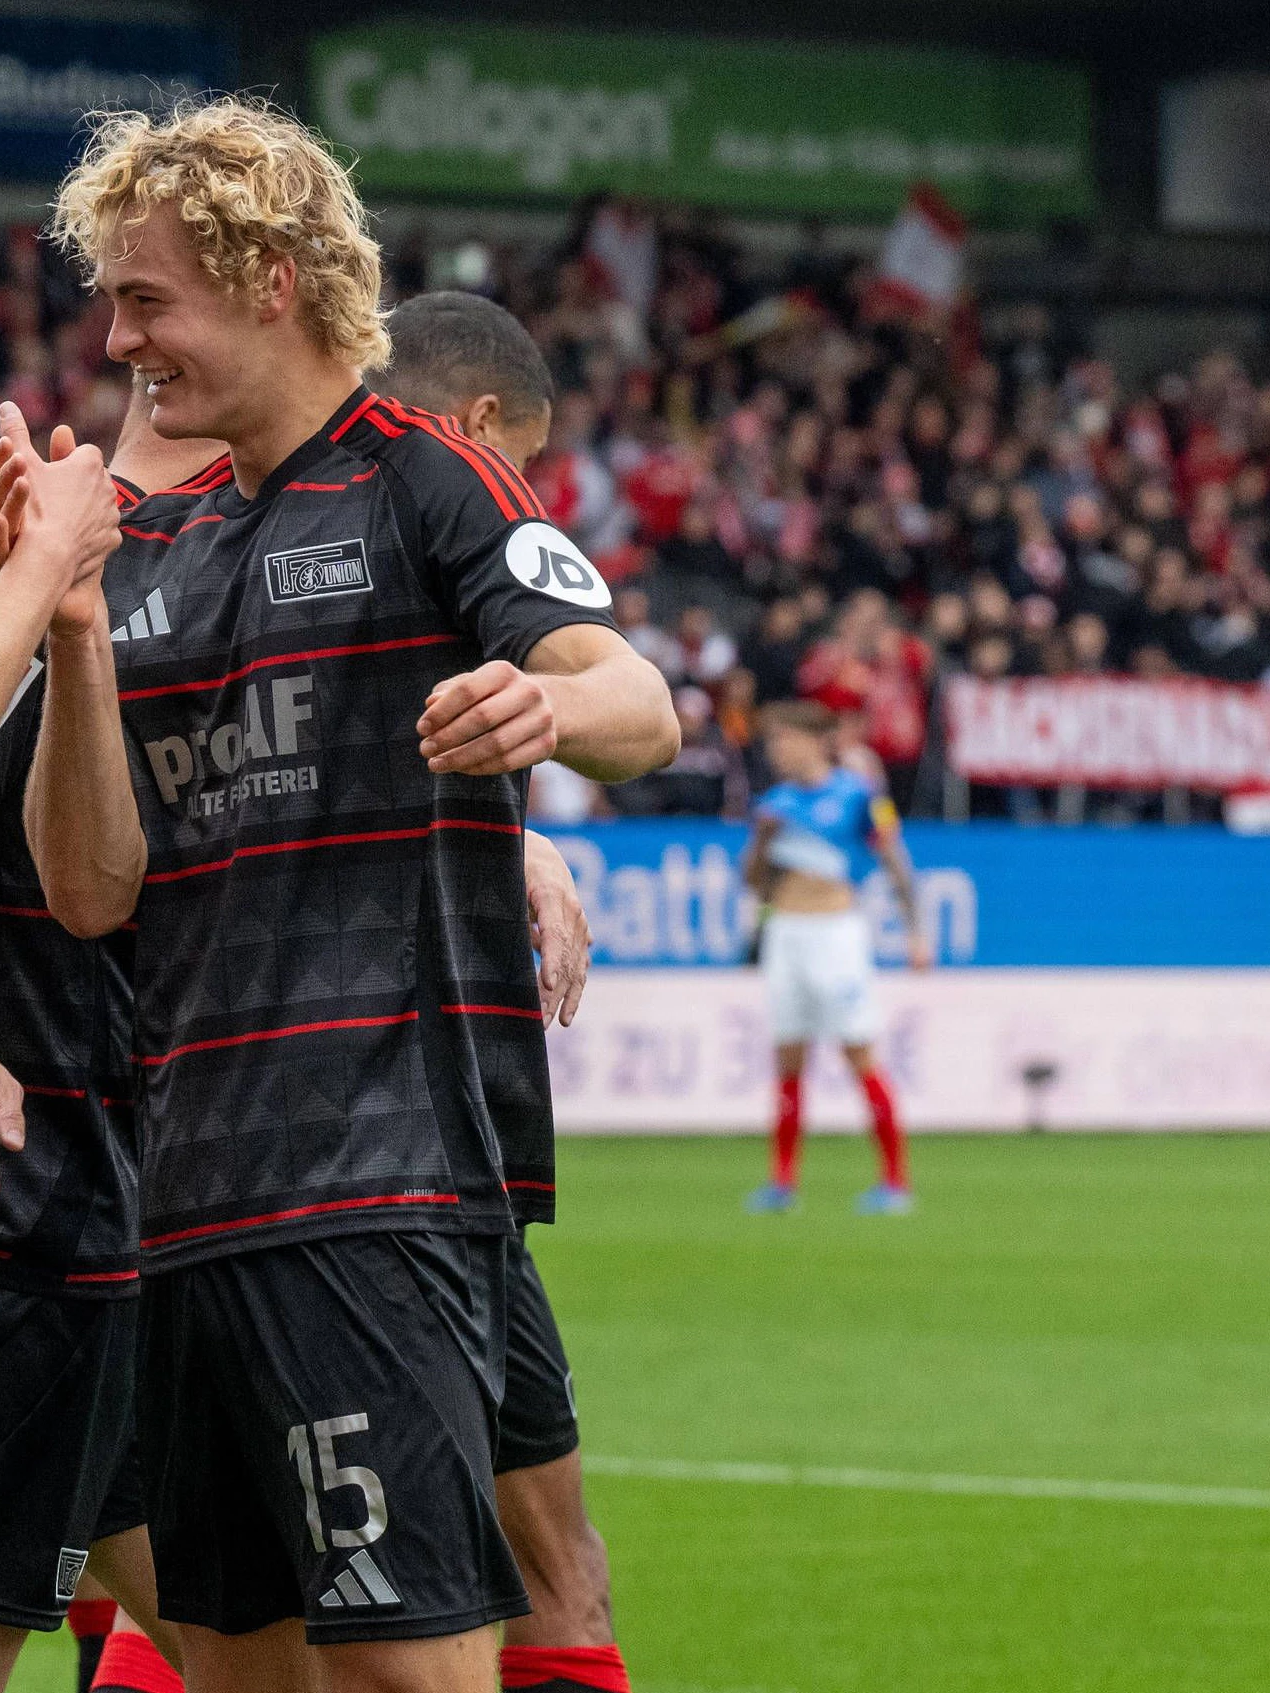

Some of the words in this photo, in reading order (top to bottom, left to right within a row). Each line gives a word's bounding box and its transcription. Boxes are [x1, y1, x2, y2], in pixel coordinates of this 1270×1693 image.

[323, 561, 364, 585] UNION
[528, 545, 595, 591] JD
[229, 765, 320, 812] FSTEREI
[286, 1411, 388, 1554] 15
